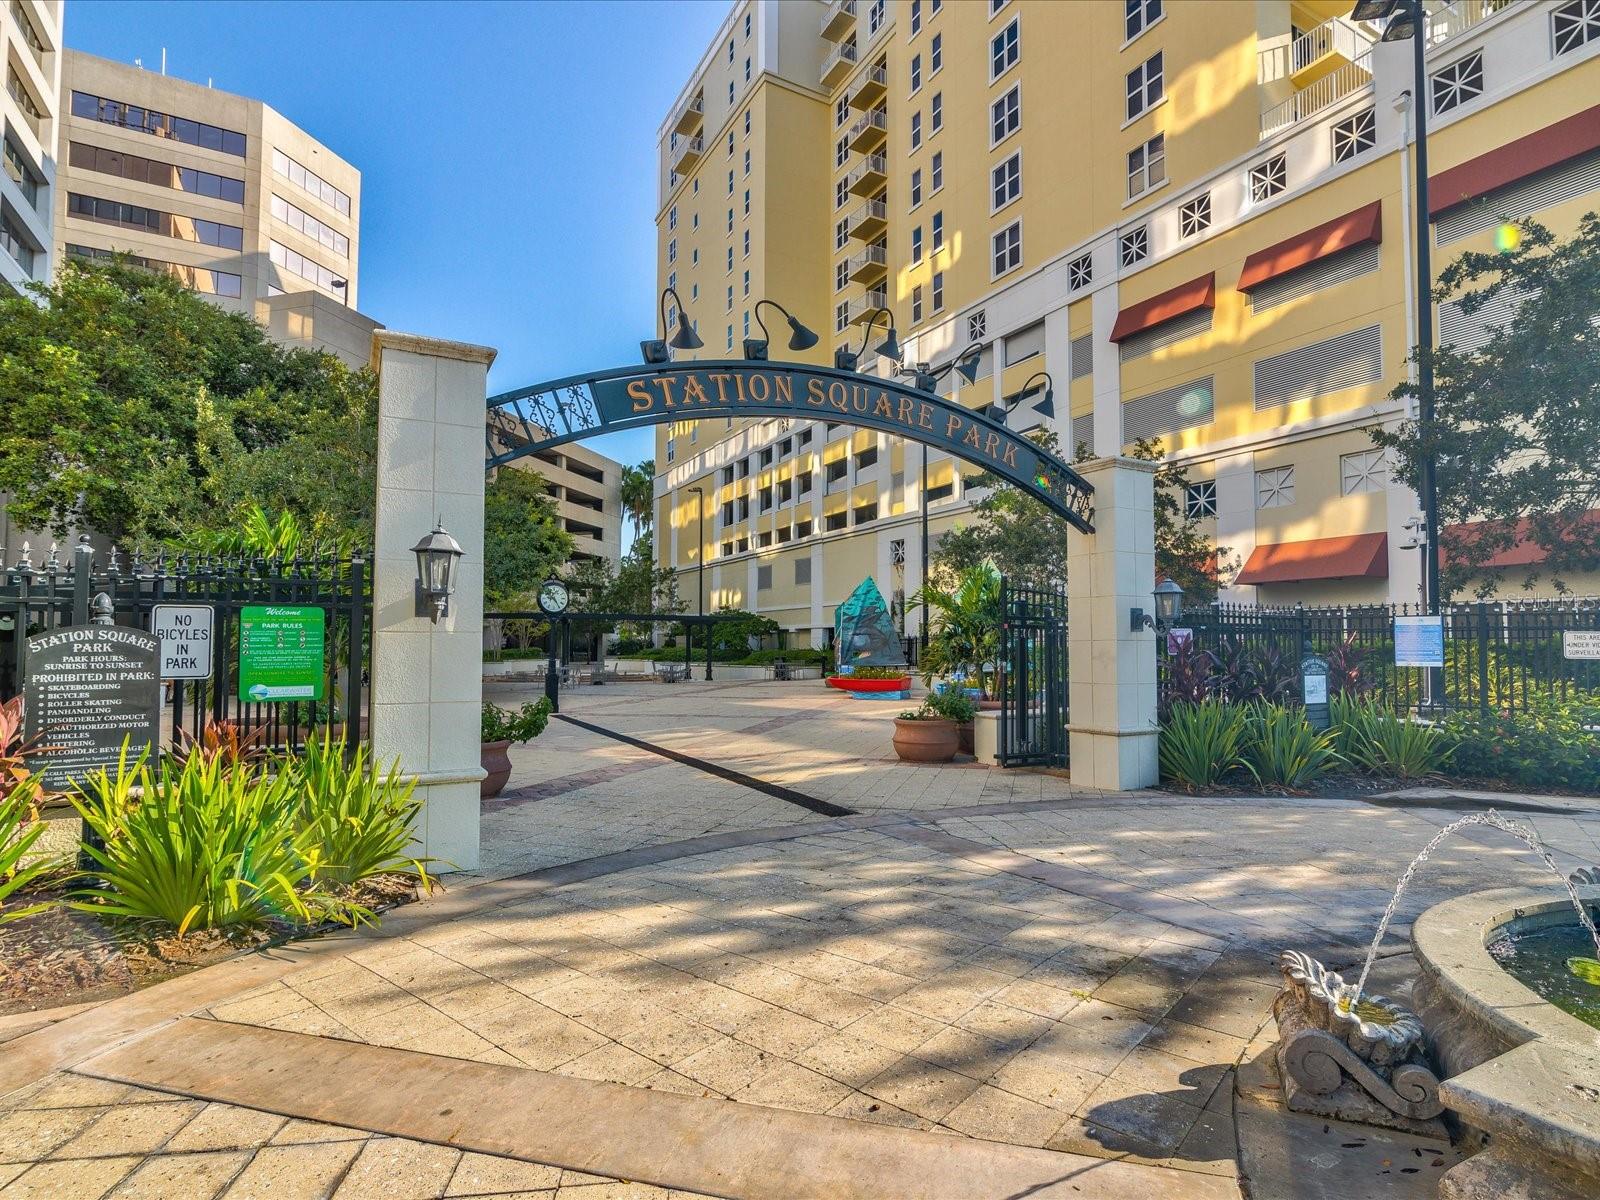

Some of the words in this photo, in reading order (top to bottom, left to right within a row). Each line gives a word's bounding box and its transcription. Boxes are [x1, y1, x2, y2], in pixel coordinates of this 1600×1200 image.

[627, 373, 794, 412] STATION
[807, 378, 935, 430] SQUARE
[946, 415, 1019, 469] PARK
[265, 607, 302, 616] Welcome
[175, 614, 192, 627] NO
[157, 628, 208, 640] BICYLES
[29, 630, 94, 653] STATION
[98, 630, 157, 652] SQUARE
[72, 643, 113, 652] PARK
[176, 644, 189, 655] IN
[166, 657, 198, 669] PARK
[32, 673, 103, 683] PROHIBITED
[106, 672, 117, 680] IN
[120, 672, 155, 680] PARK:
[47, 683, 121, 691] SKATEBOARDING
[47, 707, 112, 715] PANHANDLING
[47, 715, 102, 724] DISORDERLY
[46, 732, 90, 740] VEHICLES
[46, 748, 98, 756] ALCOHOLIC
[100, 745, 148, 753] BEVEAGES
